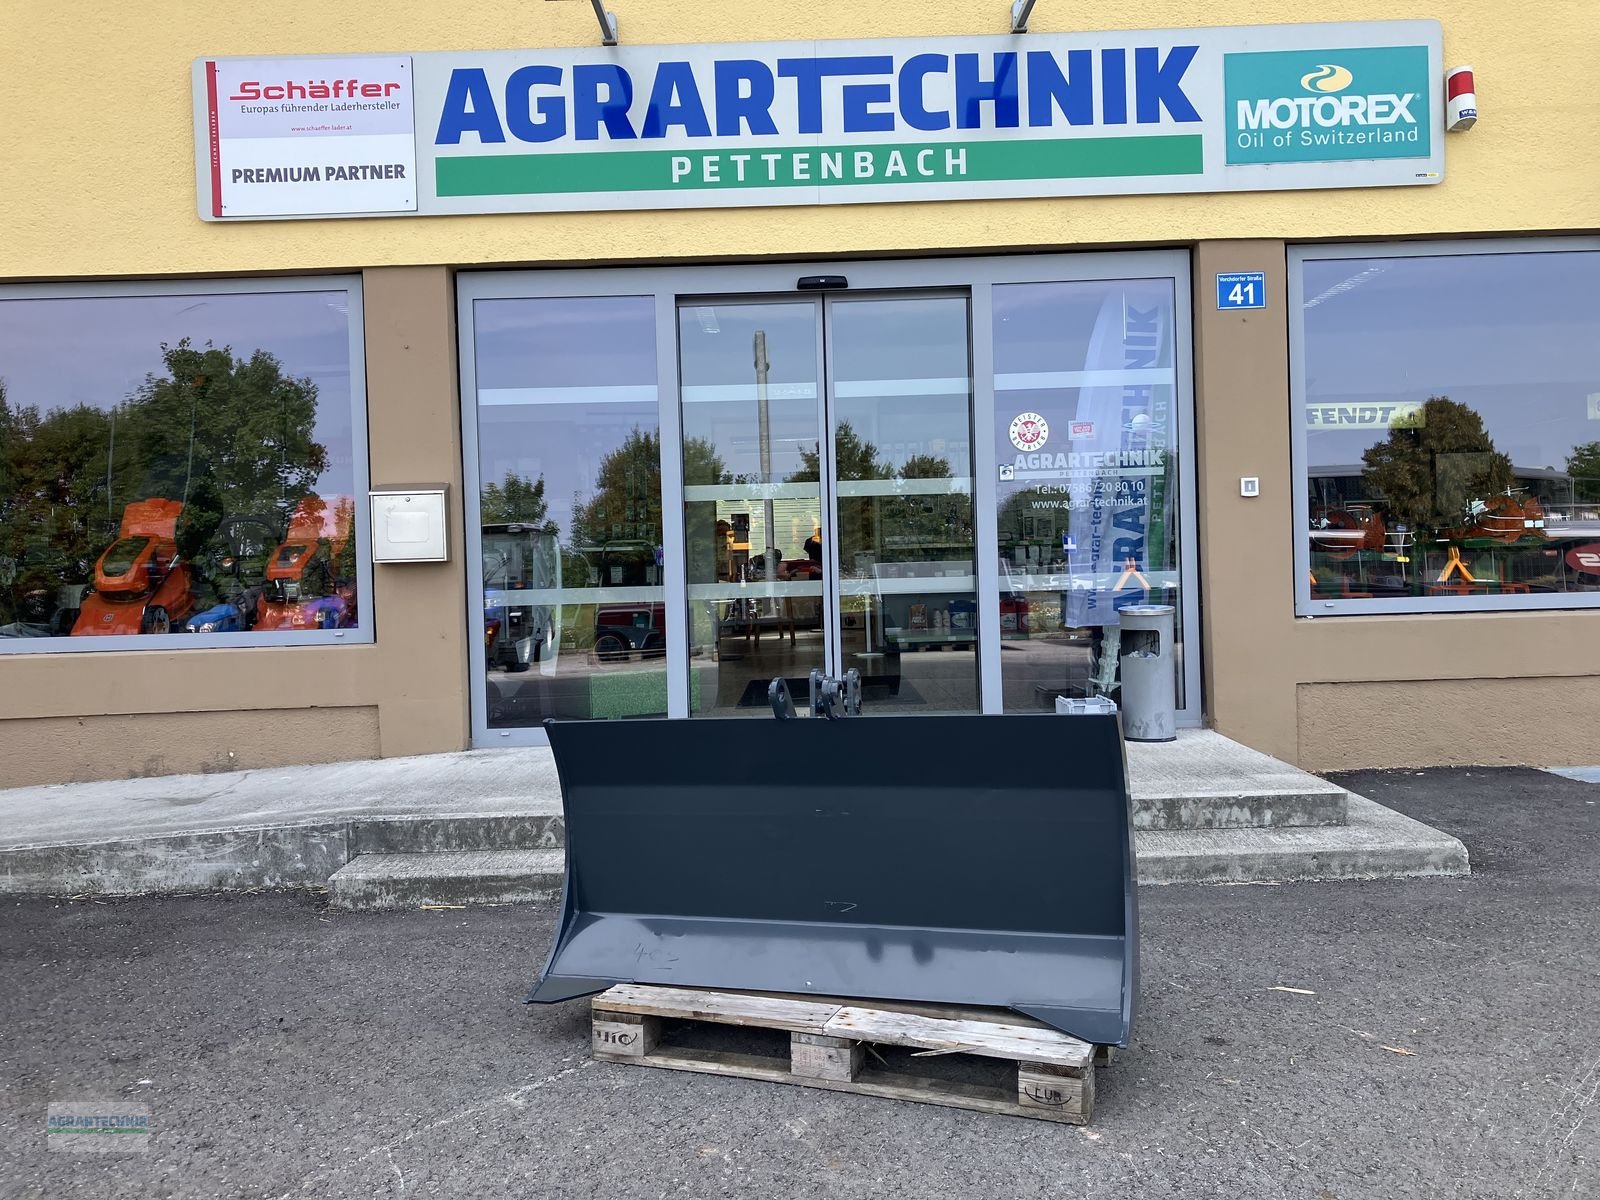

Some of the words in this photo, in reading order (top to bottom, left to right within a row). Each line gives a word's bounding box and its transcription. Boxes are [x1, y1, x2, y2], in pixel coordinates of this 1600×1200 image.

[230, 79, 400, 100] Schäffer
[435, 45, 1203, 144] AGRARTECHNIK
[241, 104, 279, 115] Europas
[281, 102, 328, 113] führender
[331, 101, 401, 111] Laderhersteller
[1237, 93, 1417, 130] MOTOREX
[1237, 132, 1264, 148] Oil
[1273, 131, 1292, 147] of
[1301, 127, 1418, 146] Switzerland
[232, 167, 321, 184] PREMIUM
[325, 164, 406, 181] PARTNER
[671, 148, 967, 183] PETTENBACH
[1228, 283, 1254, 305] 41
[1306, 406, 1396, 424] FENDT
[1014, 450, 1164, 470] AGRARTECHNIK
[1034, 484, 1057, 495] Tel.:
[1114, 481, 1128, 492] 80
[1130, 480, 1144, 492] 10
[1031, 496, 1148, 511] www.agrar-technik.at
